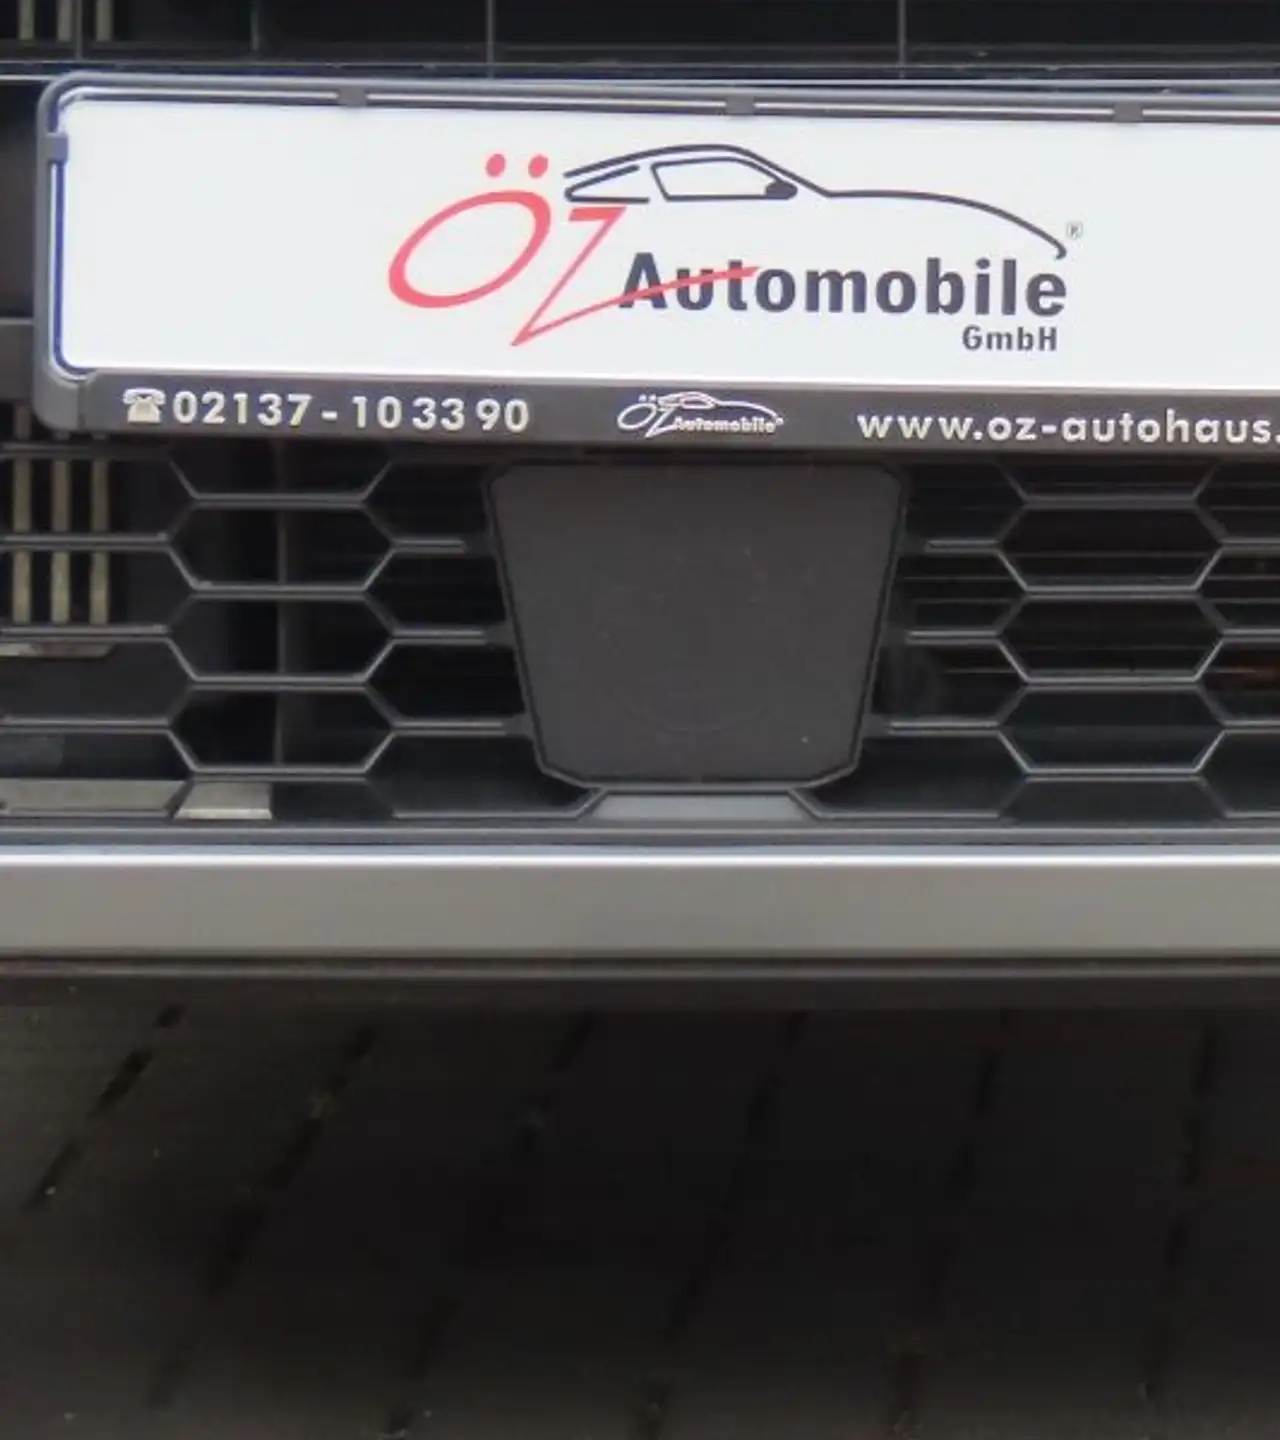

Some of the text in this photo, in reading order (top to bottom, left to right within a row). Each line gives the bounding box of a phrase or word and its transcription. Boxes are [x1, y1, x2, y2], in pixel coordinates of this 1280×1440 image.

[618, 250, 1068, 317] Automobile
[961, 324, 1059, 352] GmbH
[172, 389, 313, 427] 02137
